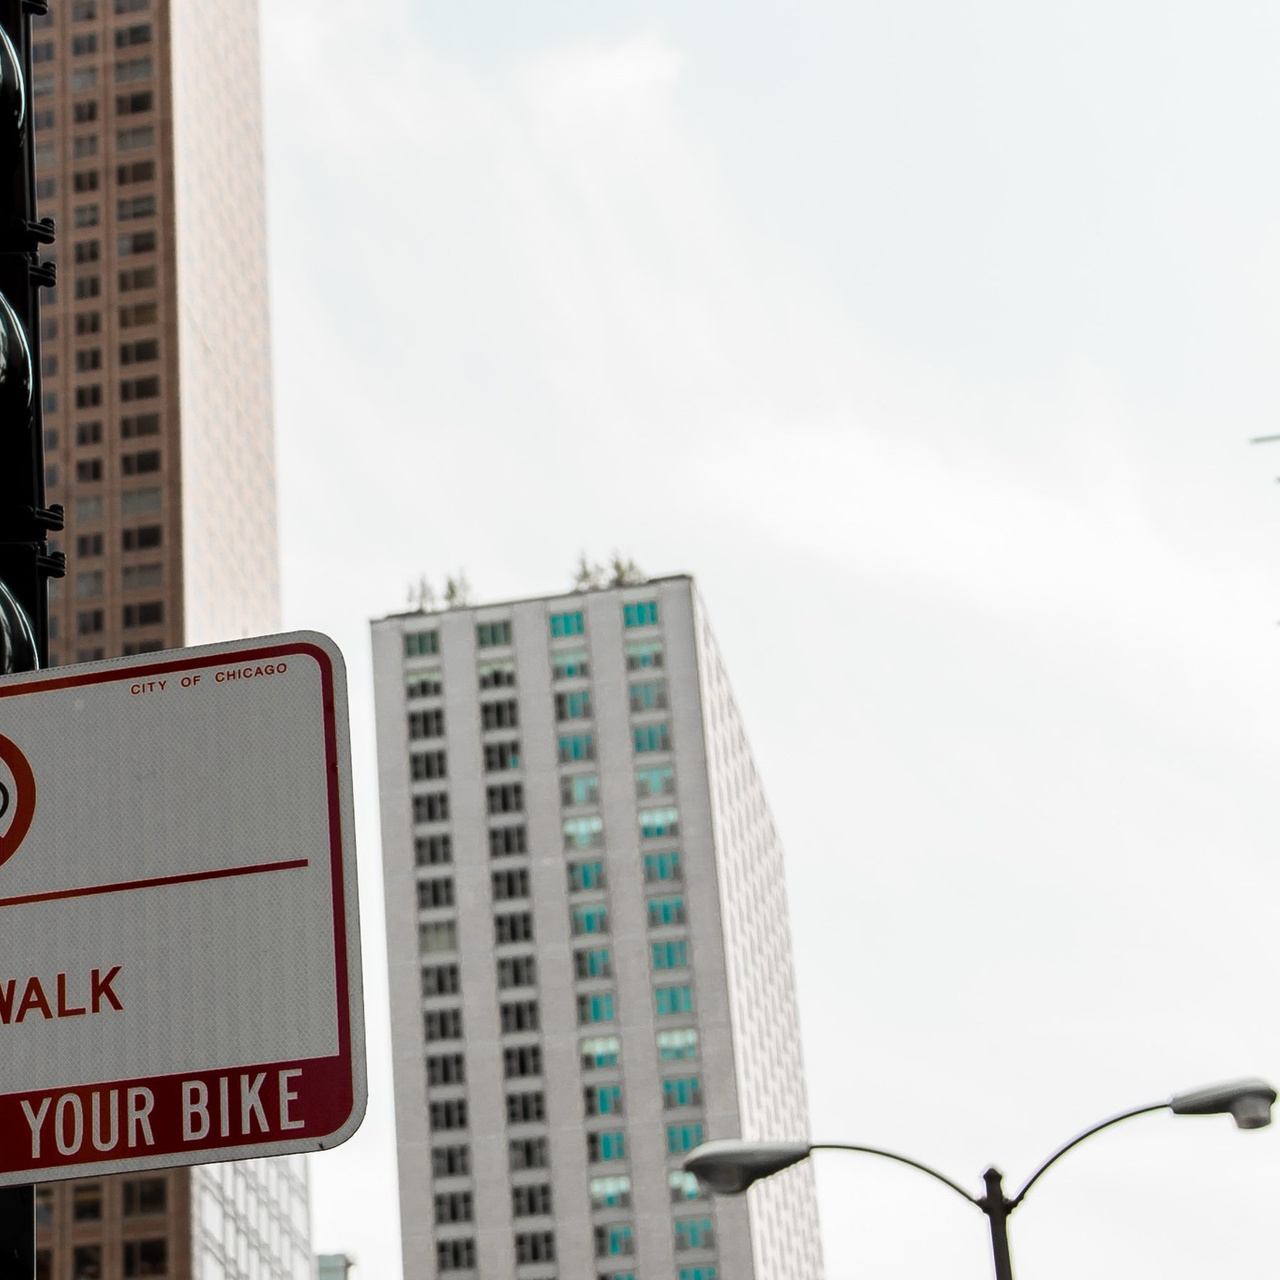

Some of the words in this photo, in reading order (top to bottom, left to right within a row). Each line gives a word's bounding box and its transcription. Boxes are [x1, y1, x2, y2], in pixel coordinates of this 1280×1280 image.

[130, 680, 168, 696] CITY
[180, 673, 202, 688] OF
[214, 662, 288, 683] CHICAGO
[20, 1086, 155, 1157] YOUR
[181, 1068, 306, 1142] BIKE
